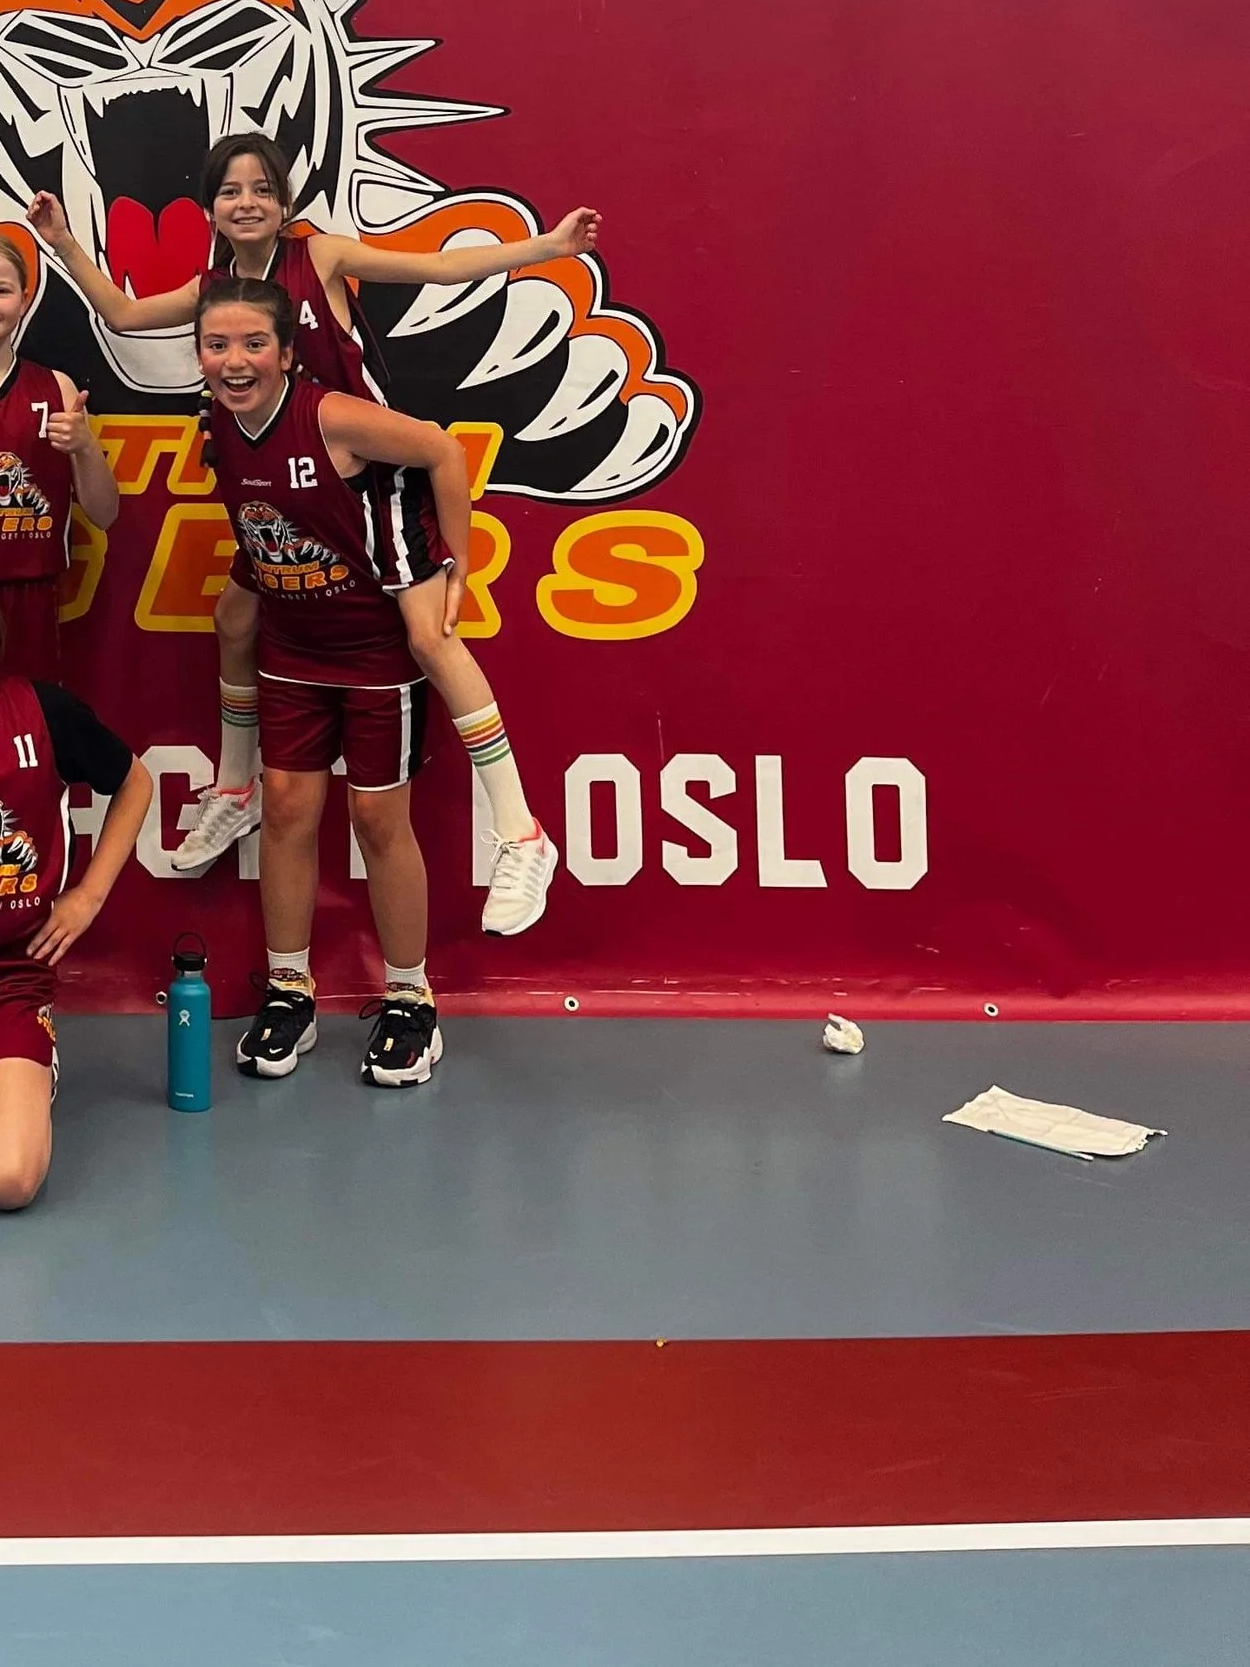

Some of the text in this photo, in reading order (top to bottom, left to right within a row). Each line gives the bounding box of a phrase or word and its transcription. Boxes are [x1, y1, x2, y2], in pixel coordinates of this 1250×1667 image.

[299, 300, 319, 330] 4
[31, 401, 49, 439] 7
[288, 457, 318, 489] 12
[13, 734, 39, 769] 11
[564, 752, 929, 891] OSLO
[9, 896, 41, 910] OSLO
